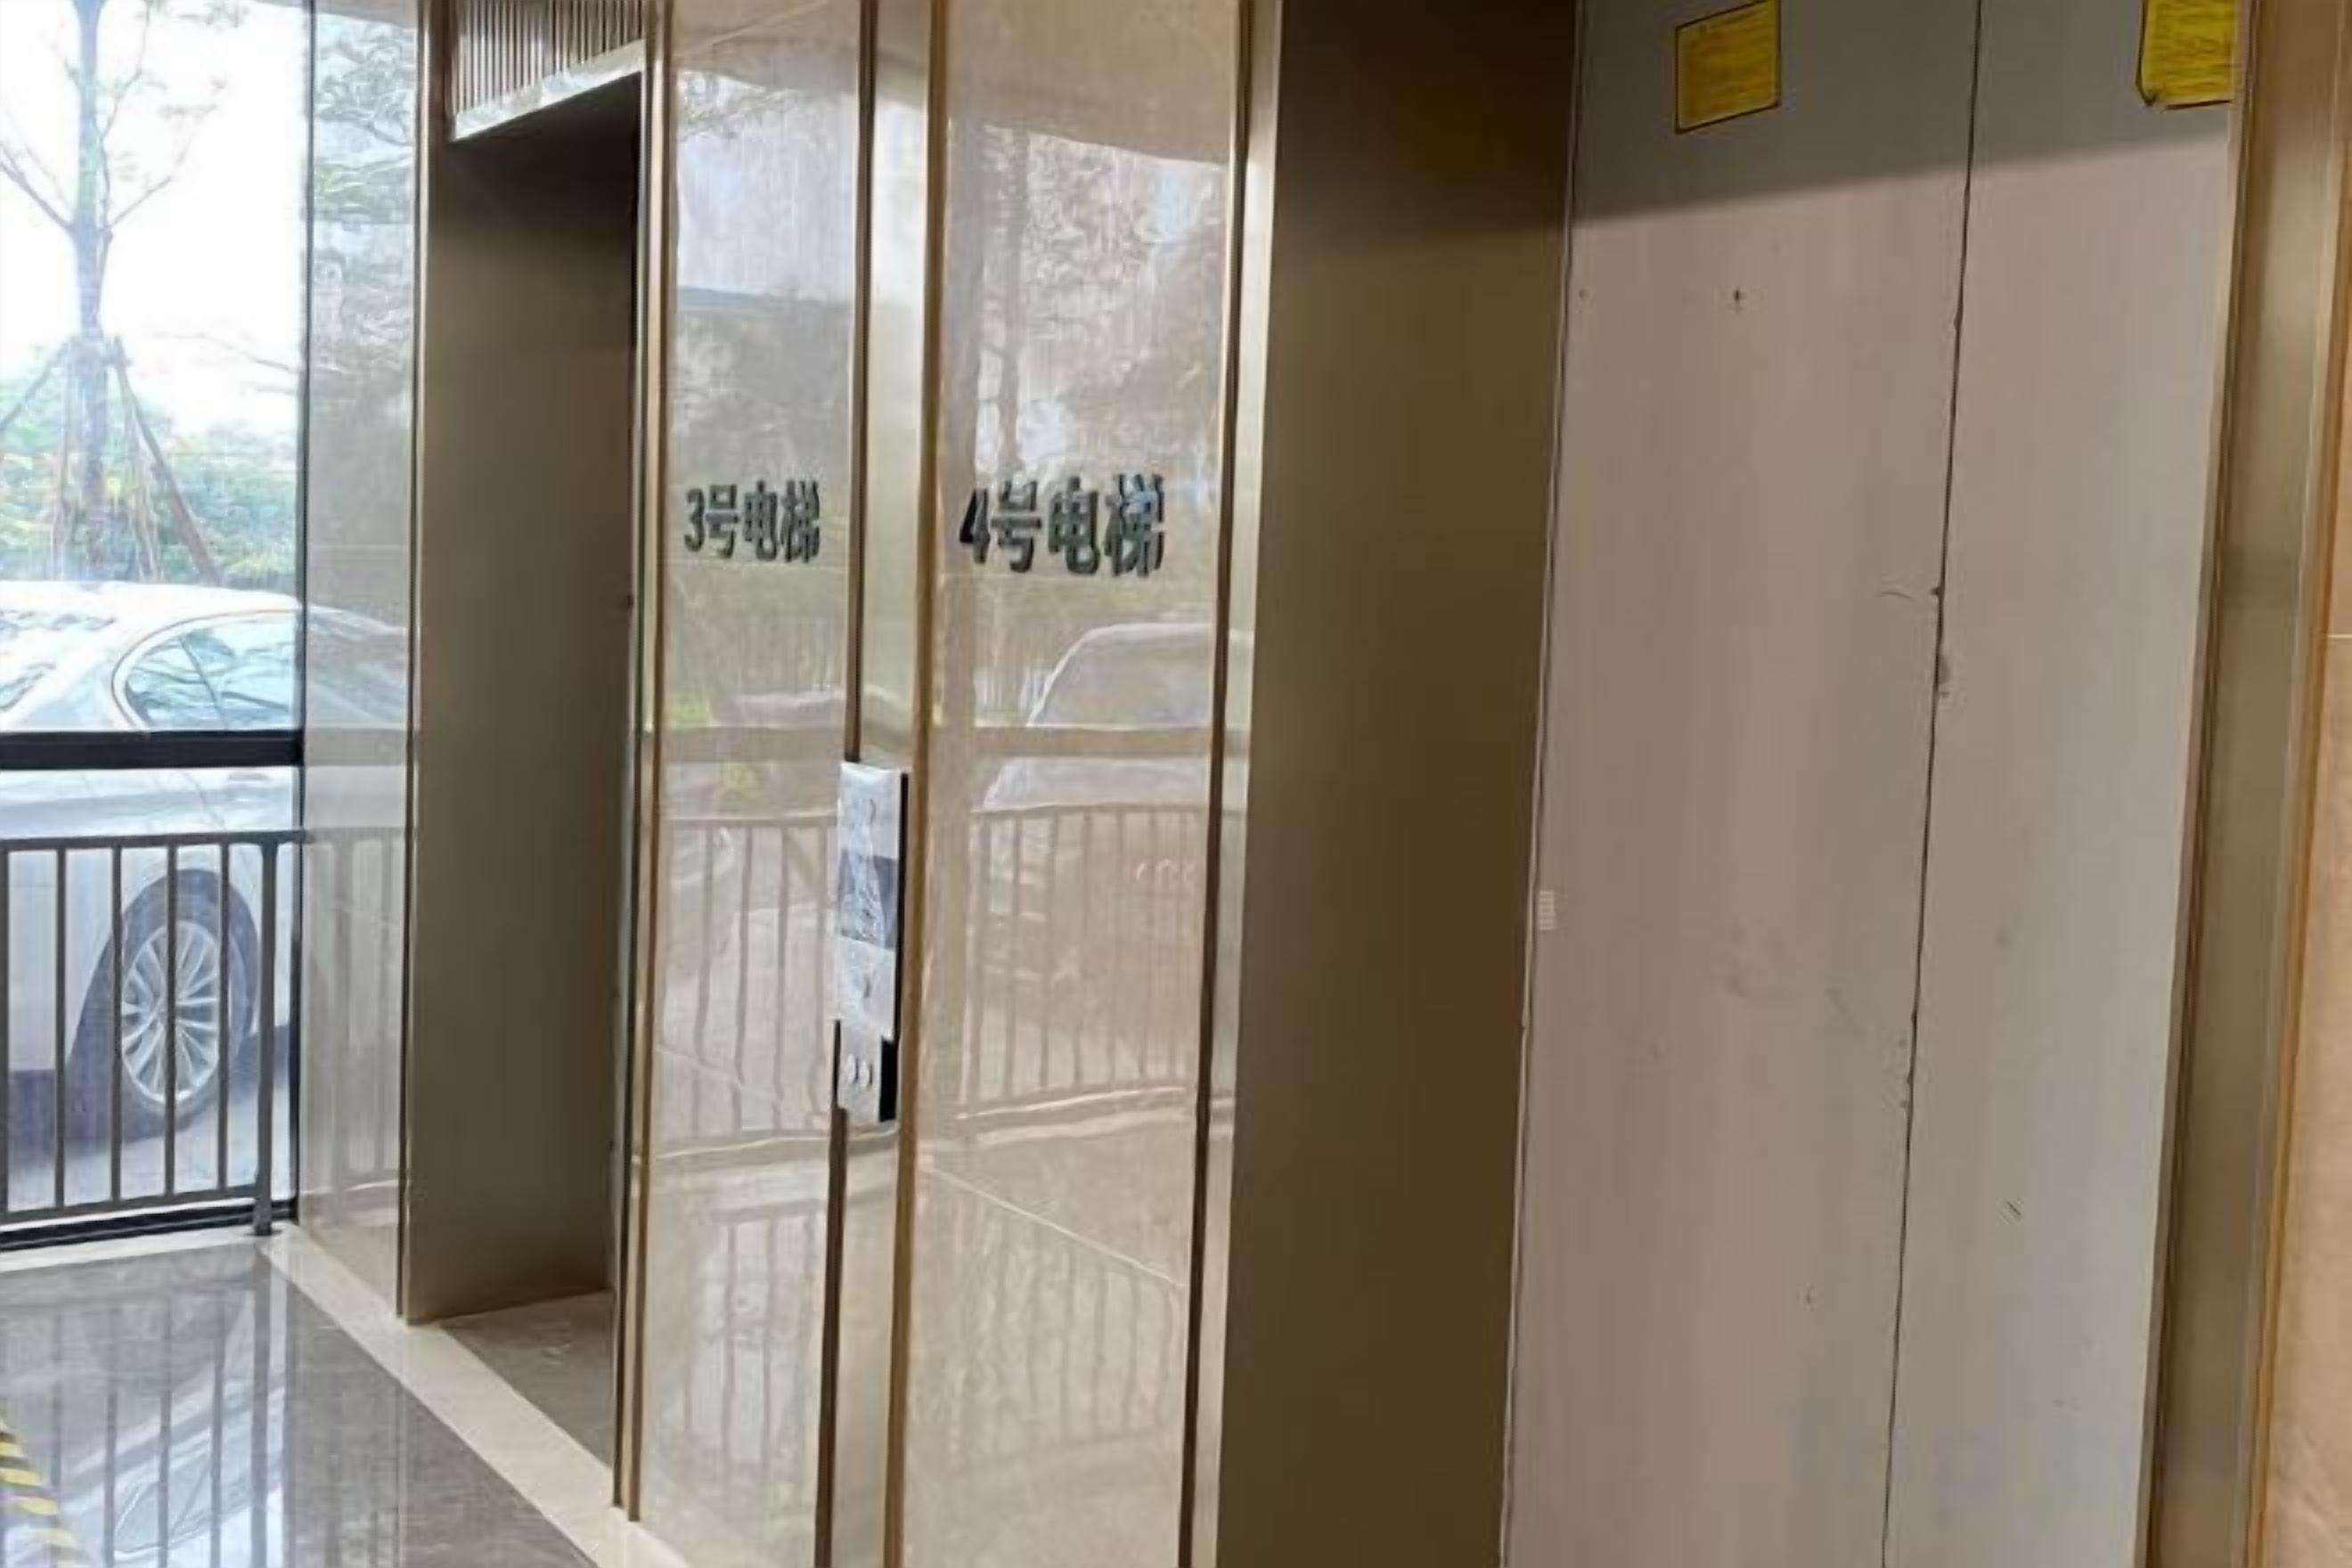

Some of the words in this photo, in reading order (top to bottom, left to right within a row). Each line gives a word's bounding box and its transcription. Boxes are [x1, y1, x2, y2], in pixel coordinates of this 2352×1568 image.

[684, 479, 820, 562] 3号电梯
[960, 473, 1164, 576] 4号电梯
